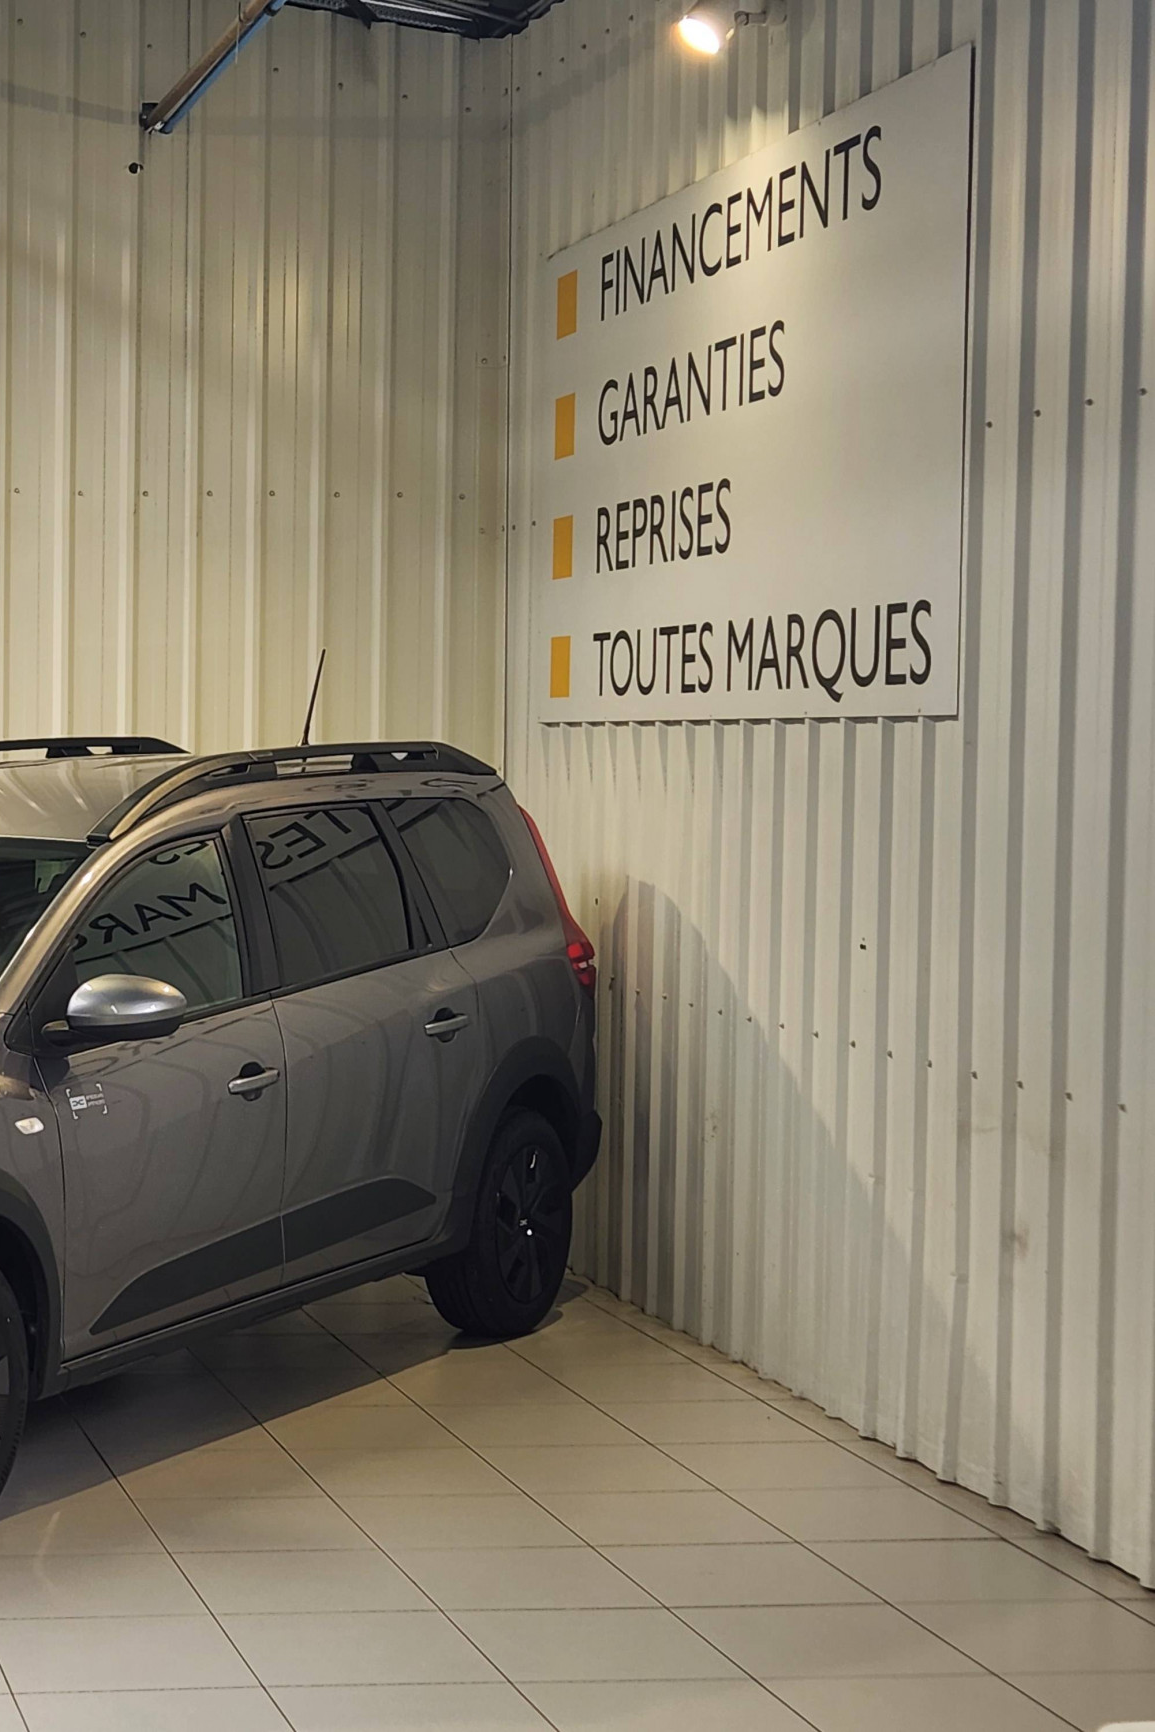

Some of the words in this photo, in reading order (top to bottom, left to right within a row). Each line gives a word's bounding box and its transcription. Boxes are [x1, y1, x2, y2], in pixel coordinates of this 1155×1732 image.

[600, 125, 882, 322] FINANCEMENTS
[598, 320, 785, 446] GARANTIES
[596, 478, 731, 574] REPRISES
[593, 623, 713, 697] TOUTES
[727, 600, 932, 703] MARQUES
